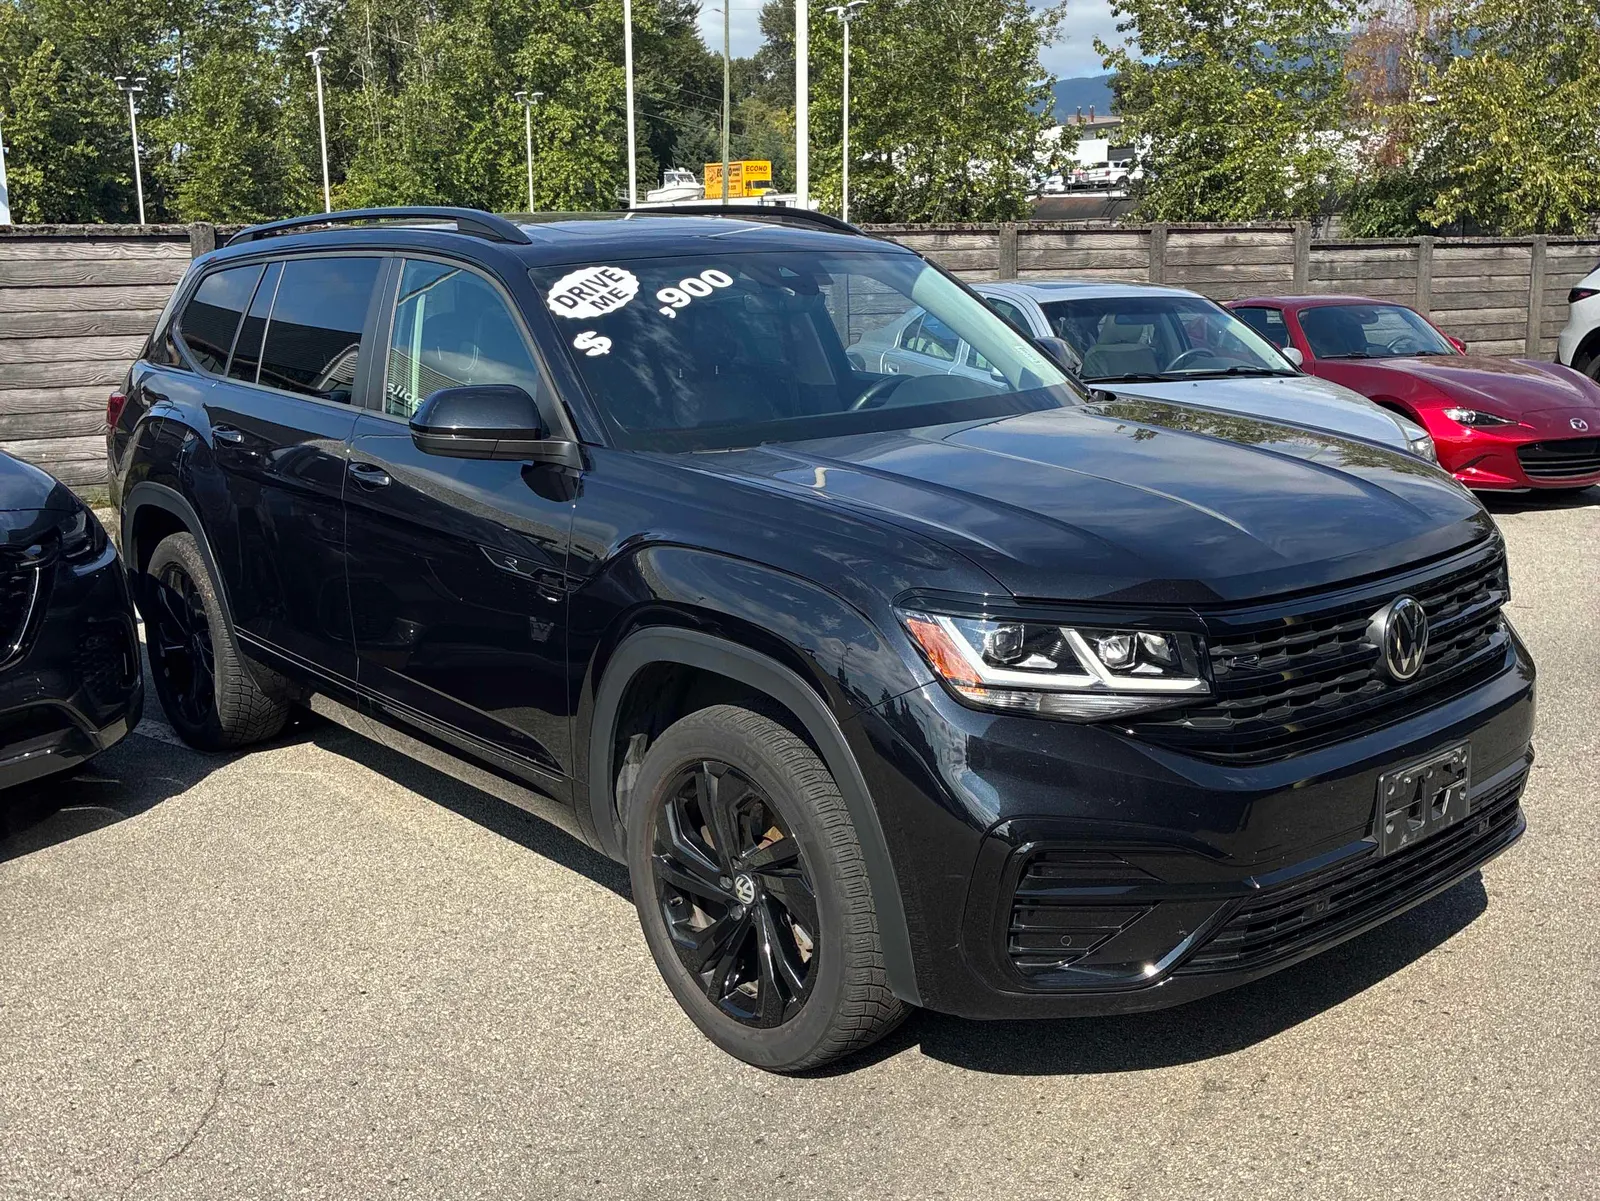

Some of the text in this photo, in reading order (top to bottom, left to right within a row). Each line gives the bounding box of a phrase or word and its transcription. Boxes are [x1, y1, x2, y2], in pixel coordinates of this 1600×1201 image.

[716, 168, 732, 177] ECO
[553, 268, 625, 310] DRIVE
[589, 286, 630, 311] ME
[573, 269, 734, 357] $ ,900
